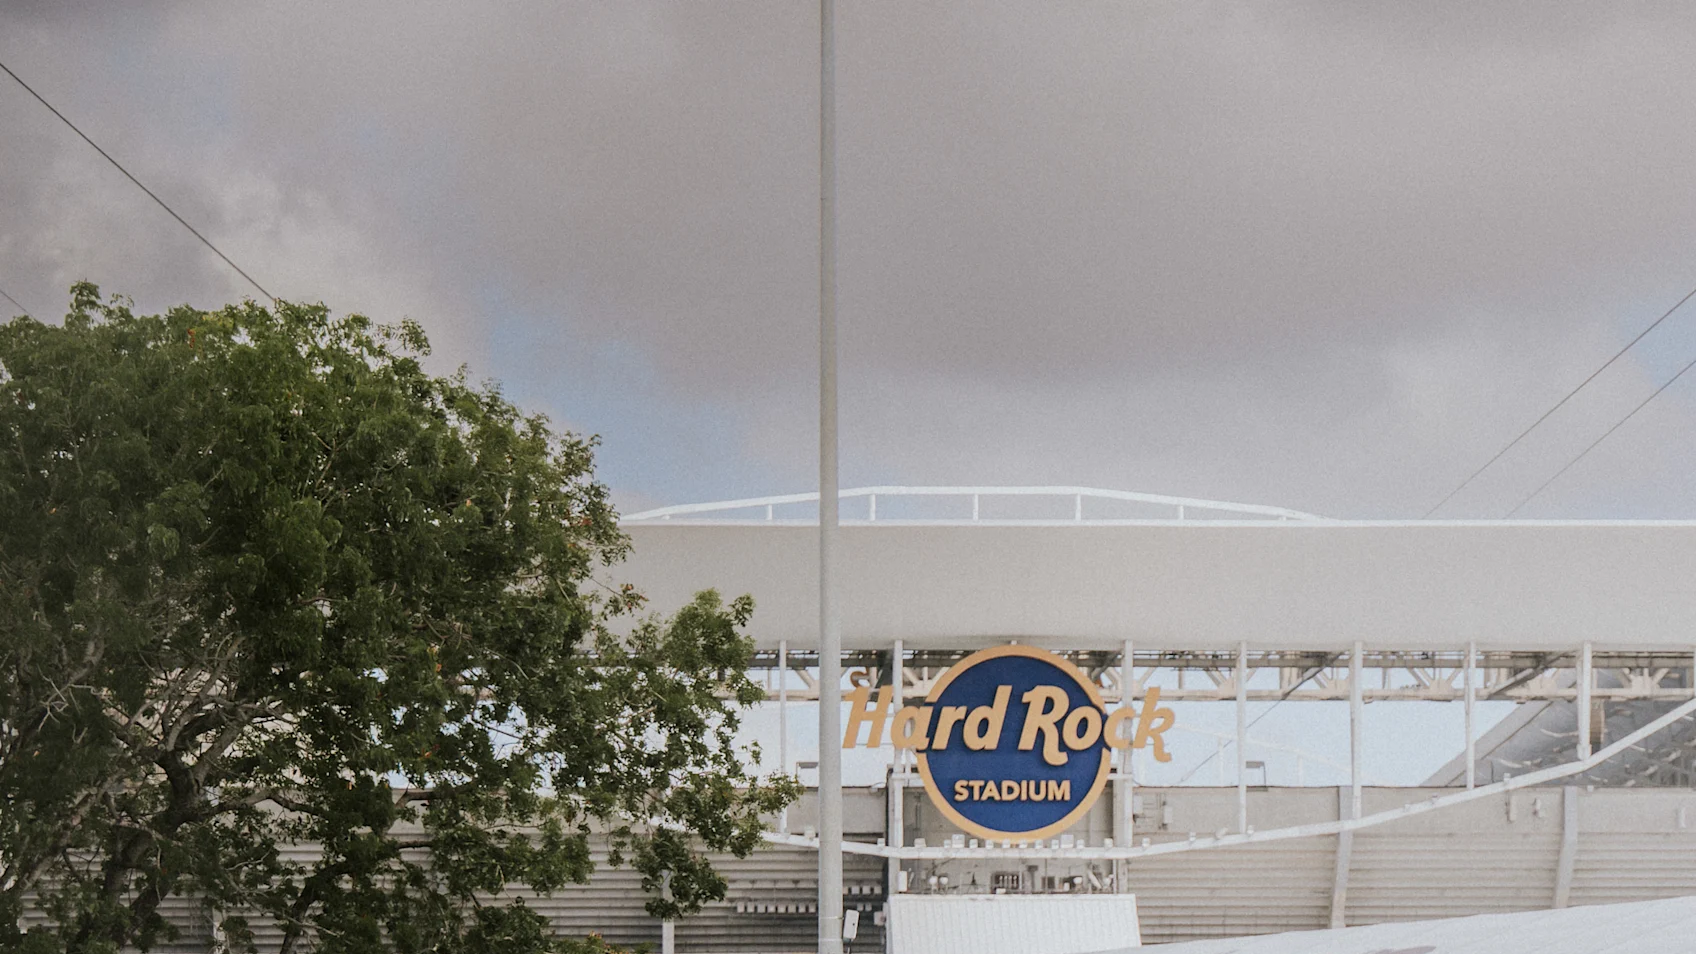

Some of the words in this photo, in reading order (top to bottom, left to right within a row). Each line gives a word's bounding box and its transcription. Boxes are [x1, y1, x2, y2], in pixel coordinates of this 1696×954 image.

[842, 672, 1013, 752] Hard
[1017, 685, 1176, 766] Rock
[954, 780, 1071, 801] STADIUM
